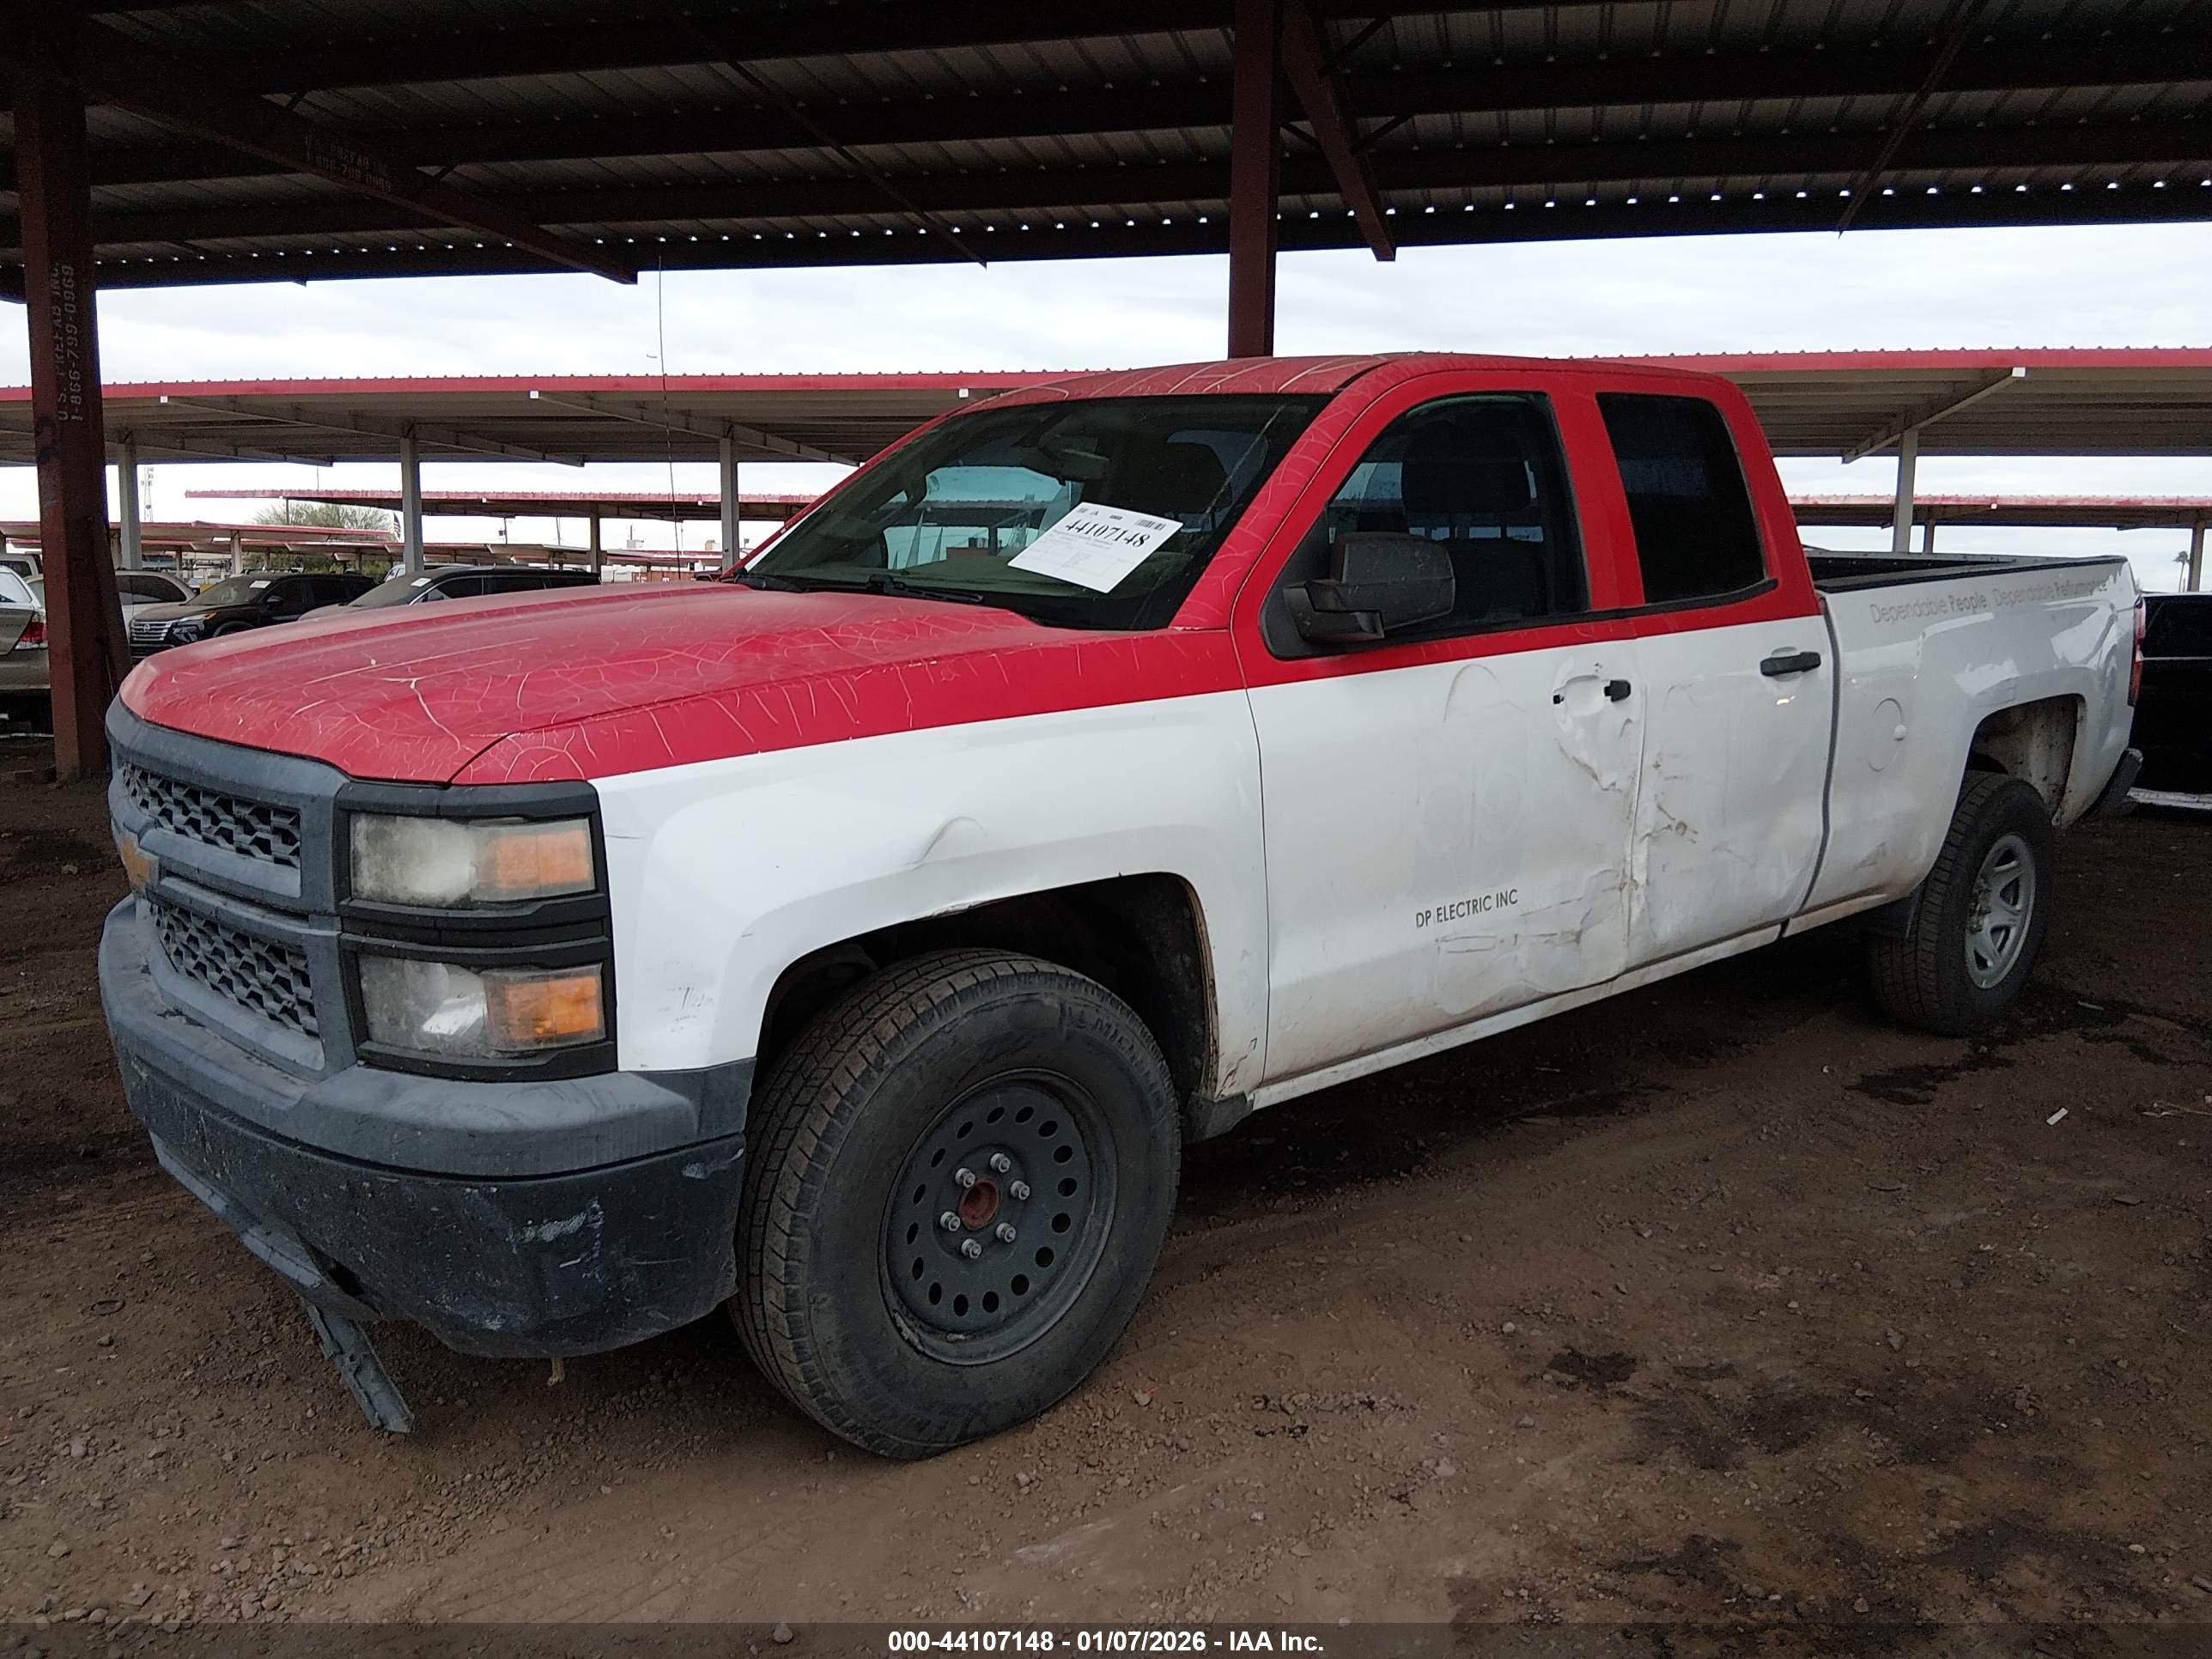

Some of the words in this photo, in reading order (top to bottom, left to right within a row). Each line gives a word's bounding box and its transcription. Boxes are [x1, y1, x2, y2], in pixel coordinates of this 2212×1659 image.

[61, 264, 83, 421] 1-866-799-0969
[1065, 519, 1152, 549] 44107148
[1869, 598, 1948, 624] Dependable
[1948, 593, 1988, 616] People
[1415, 909, 1432, 928] DP
[1436, 895, 1492, 924] ELECTRIC
[1495, 889, 1519, 908] INC
